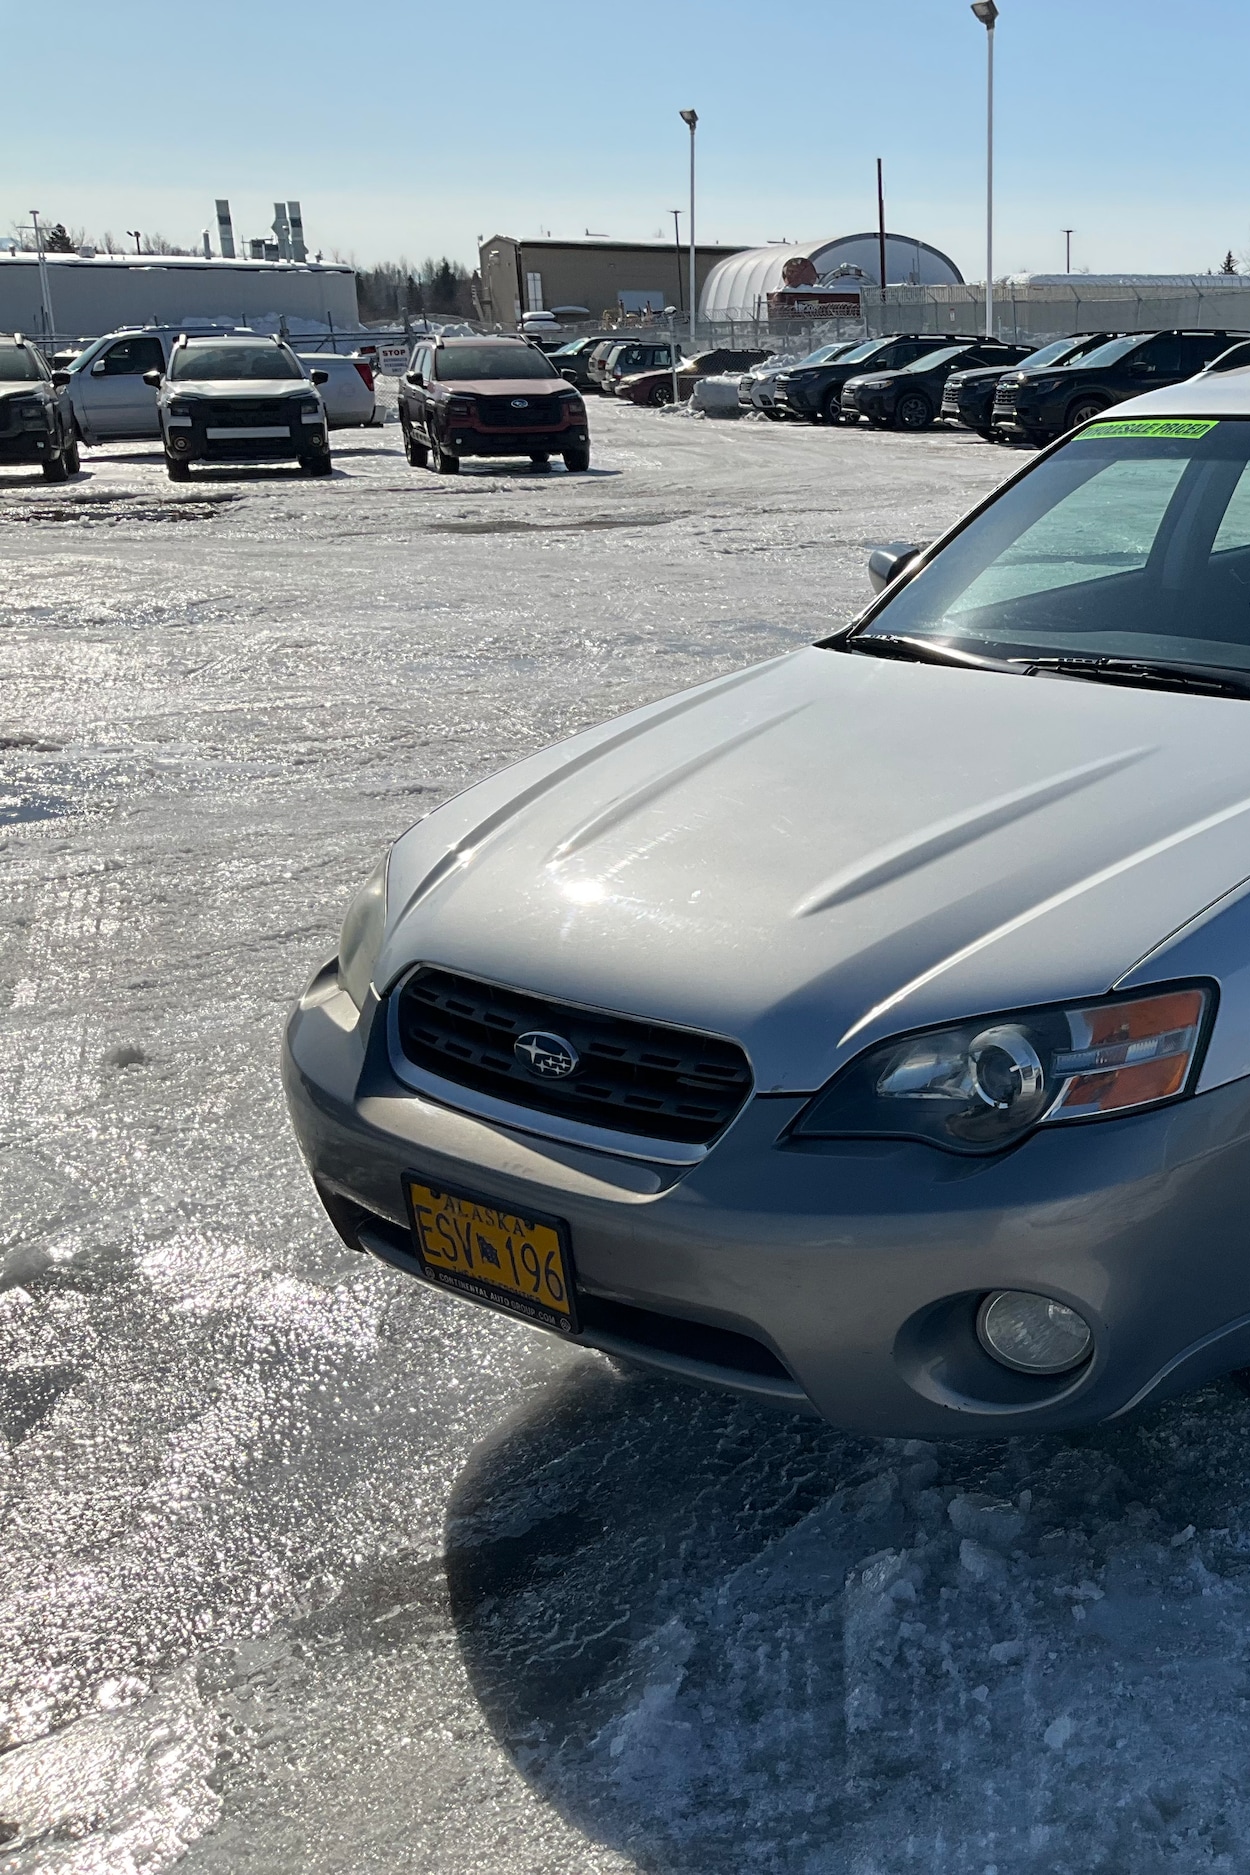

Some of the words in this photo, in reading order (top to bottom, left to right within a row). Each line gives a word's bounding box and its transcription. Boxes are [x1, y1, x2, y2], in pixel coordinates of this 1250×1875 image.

[382, 349, 406, 357] STOP
[1081, 422, 1156, 437] WHOLESALE
[1151, 422, 1210, 436] PRICED
[444, 1196, 525, 1238] ALASKA
[415, 1204, 474, 1269] ESV
[505, 1236, 564, 1302] 196
[438, 1272, 489, 1299] CONTINENTAL
[490, 1292, 510, 1307] AUTO
